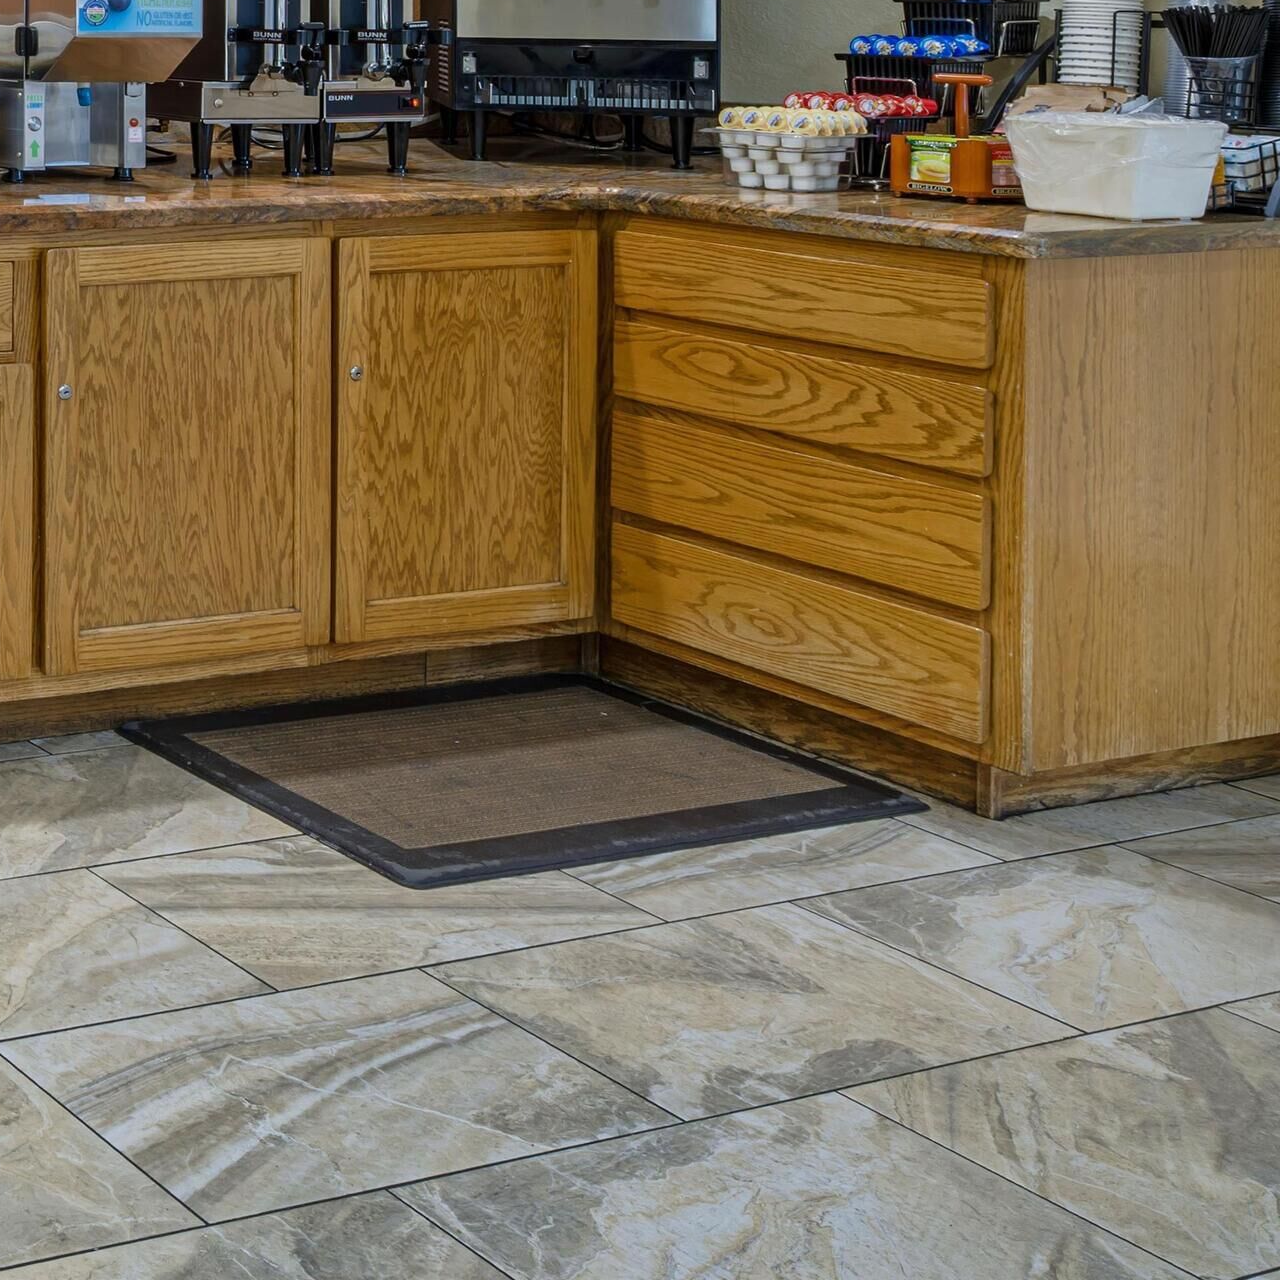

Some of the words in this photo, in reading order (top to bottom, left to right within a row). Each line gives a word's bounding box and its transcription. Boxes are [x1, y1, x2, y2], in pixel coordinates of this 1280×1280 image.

[136, 11, 152, 26] NO
[253, 31, 283, 39] BUNN
[357, 31, 388, 39] BUNN
